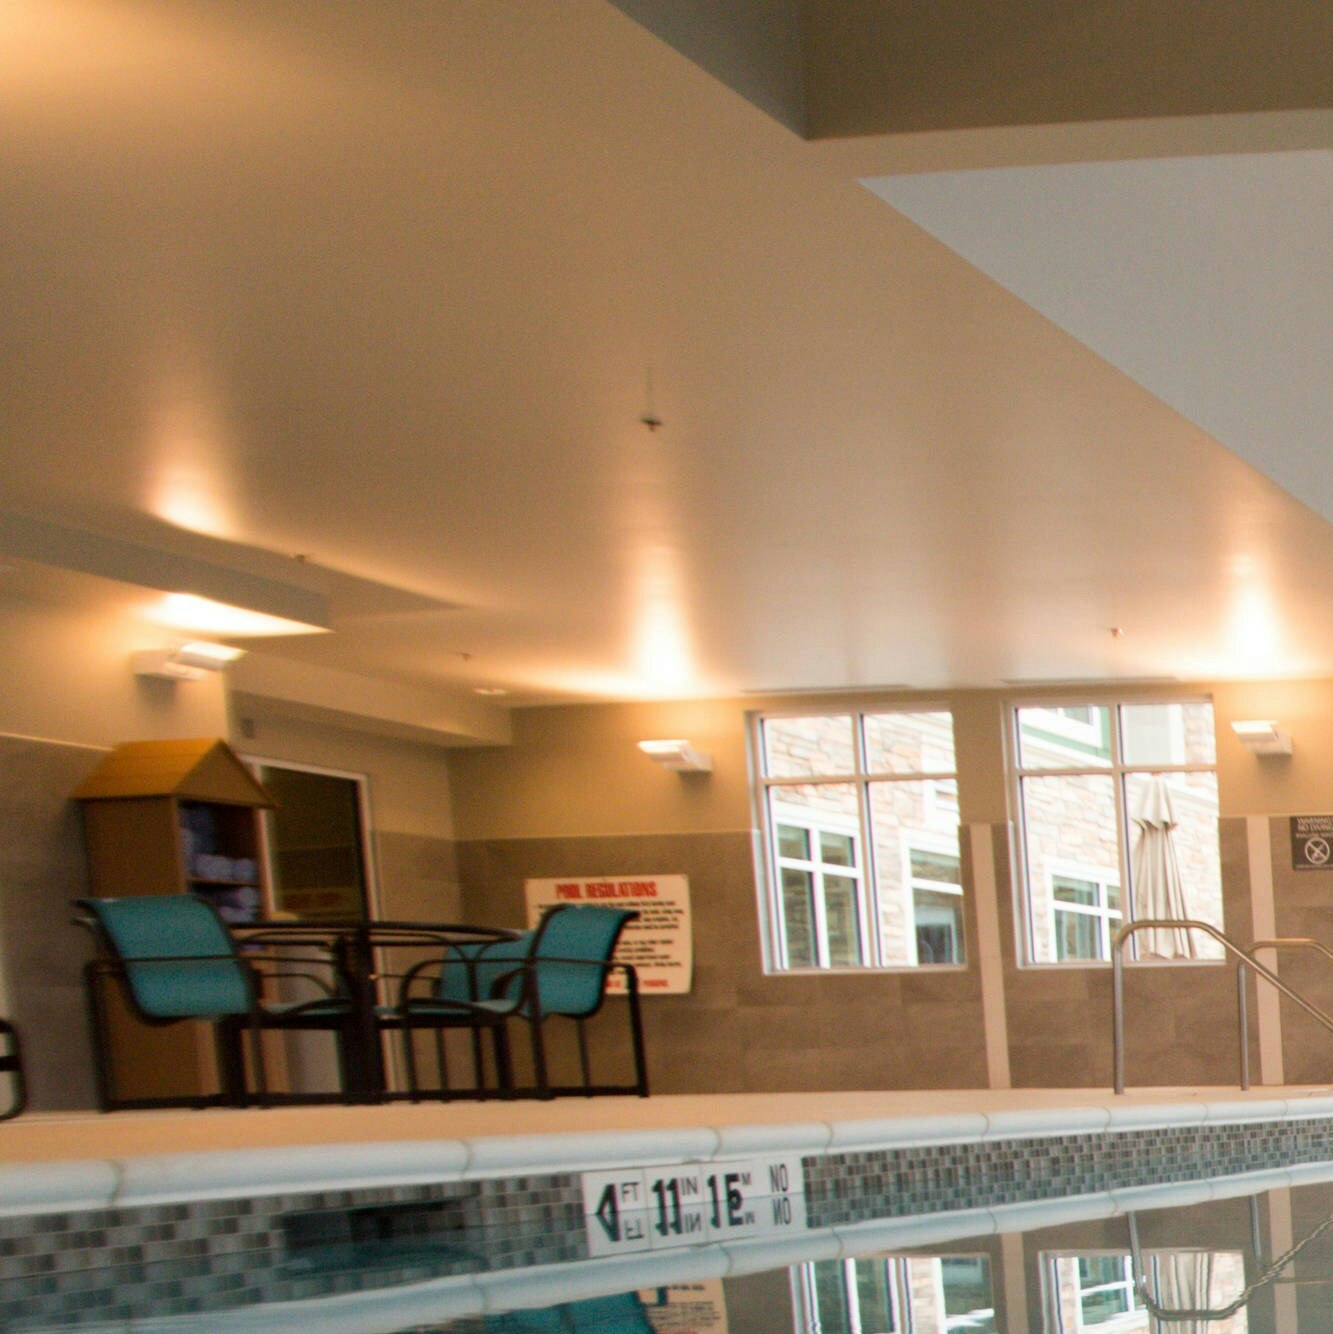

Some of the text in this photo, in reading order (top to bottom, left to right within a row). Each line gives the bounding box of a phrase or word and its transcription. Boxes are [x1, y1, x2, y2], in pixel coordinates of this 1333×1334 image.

[556, 881, 658, 899] POOL REGULATIONS
[621, 1182, 639, 1201] FT
[681, 1177, 699, 1196] IN
[769, 1163, 789, 1193] NO
